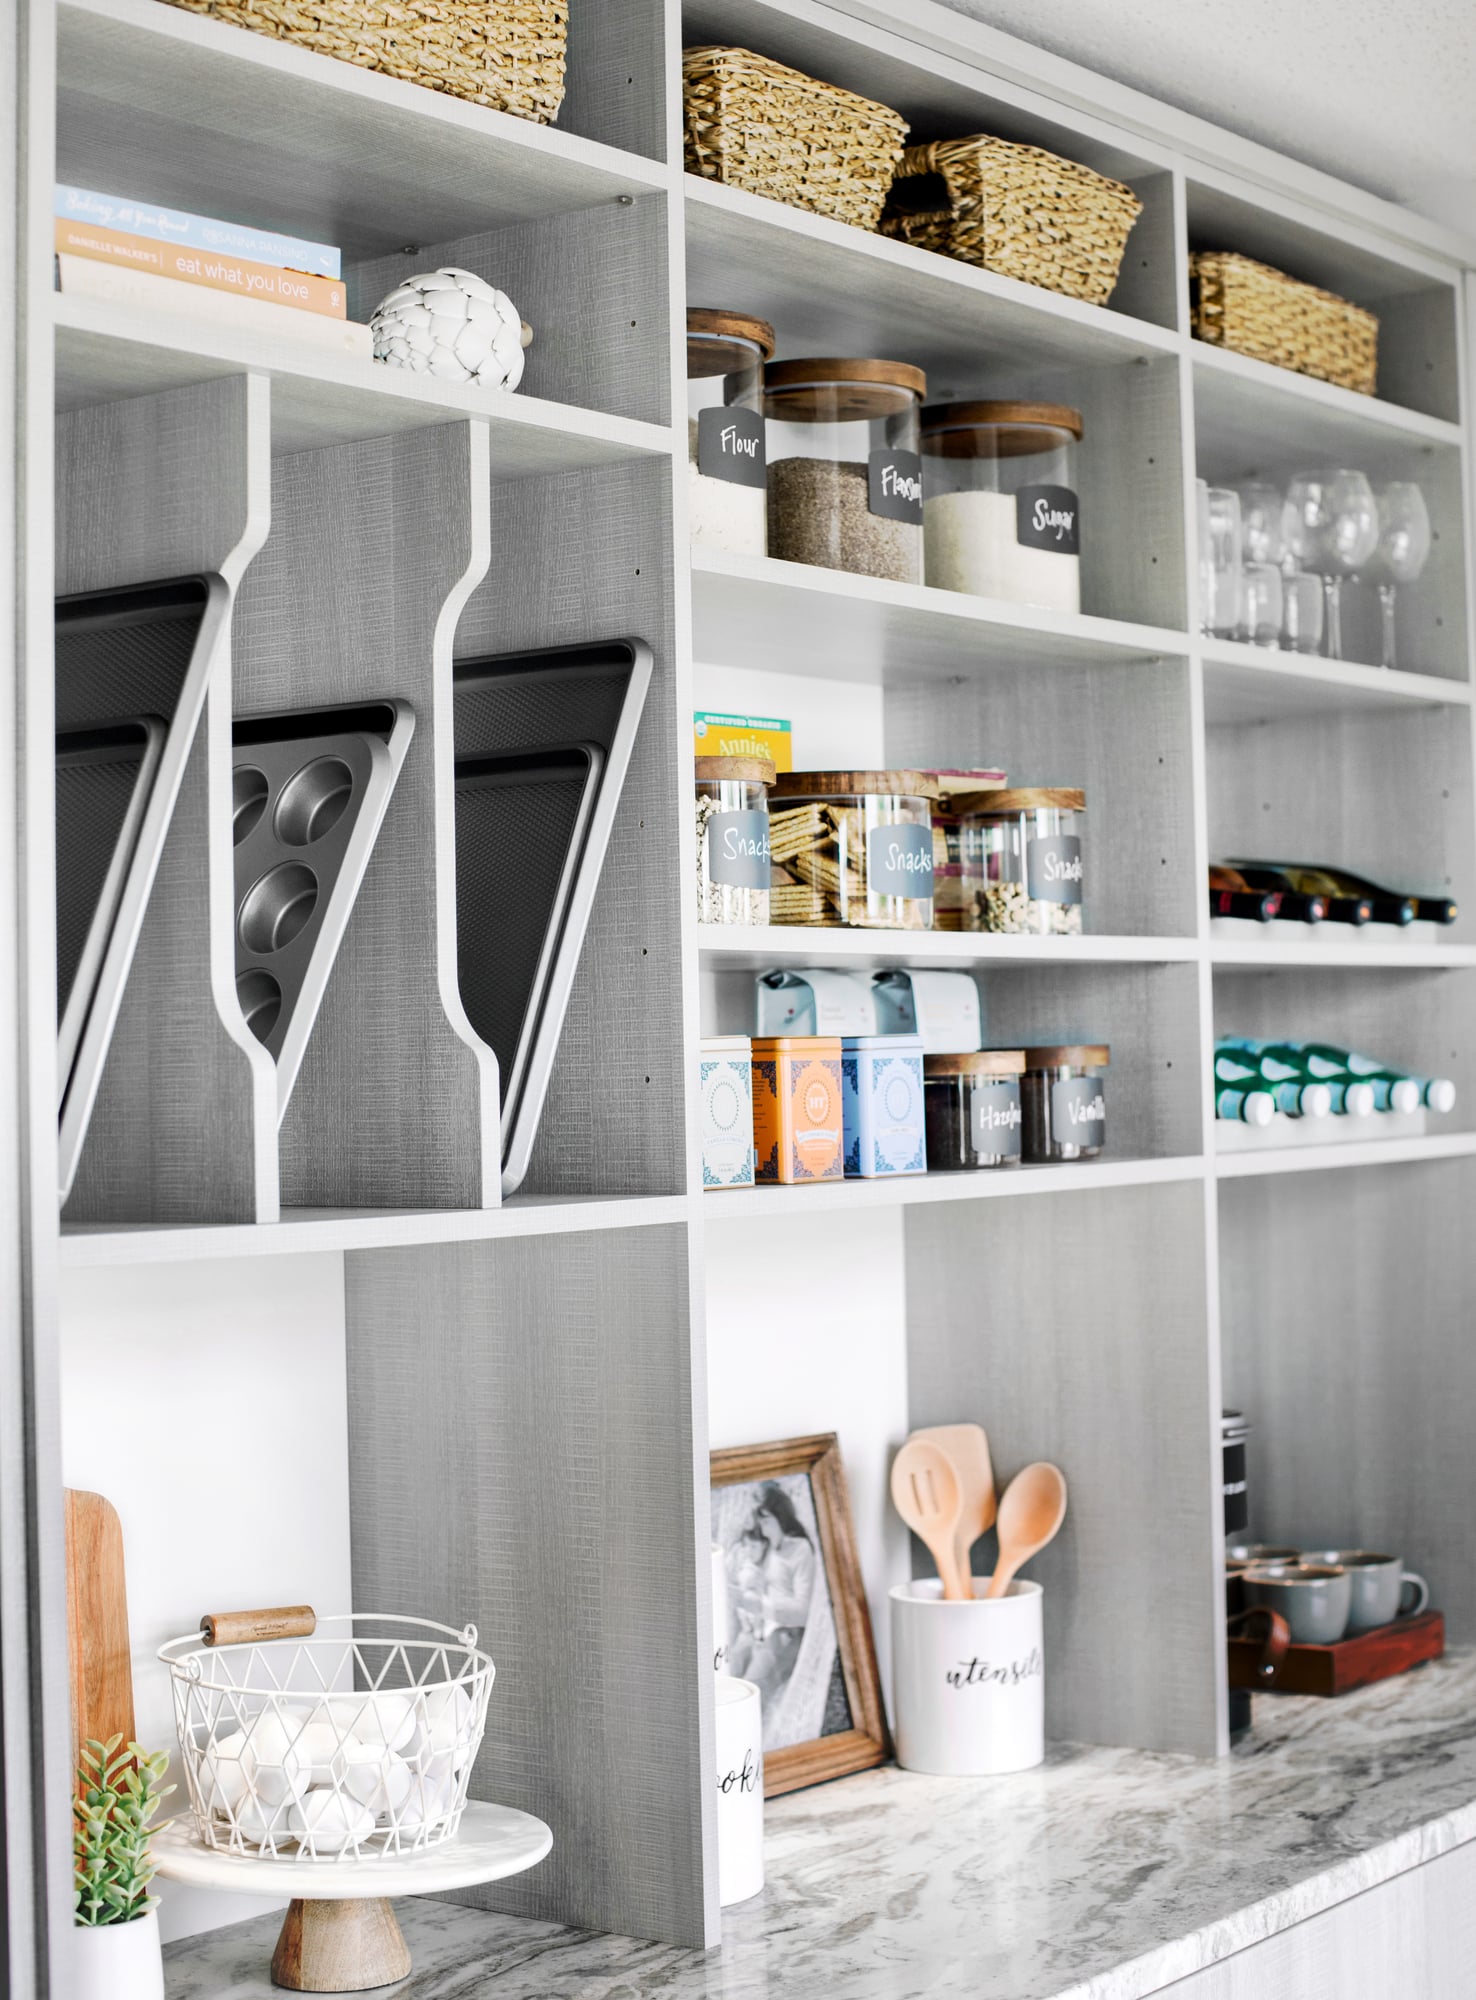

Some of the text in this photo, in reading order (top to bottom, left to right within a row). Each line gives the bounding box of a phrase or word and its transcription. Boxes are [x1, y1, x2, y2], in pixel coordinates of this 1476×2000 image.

[68, 234, 158, 264] DANIELLE WALKER'S
[176, 257, 309, 300] eat what you love
[720, 425, 760, 458] Flour
[1032, 498, 1074, 541] Sugar
[720, 734, 772, 760] Annie's
[885, 842, 932, 874] Snacks
